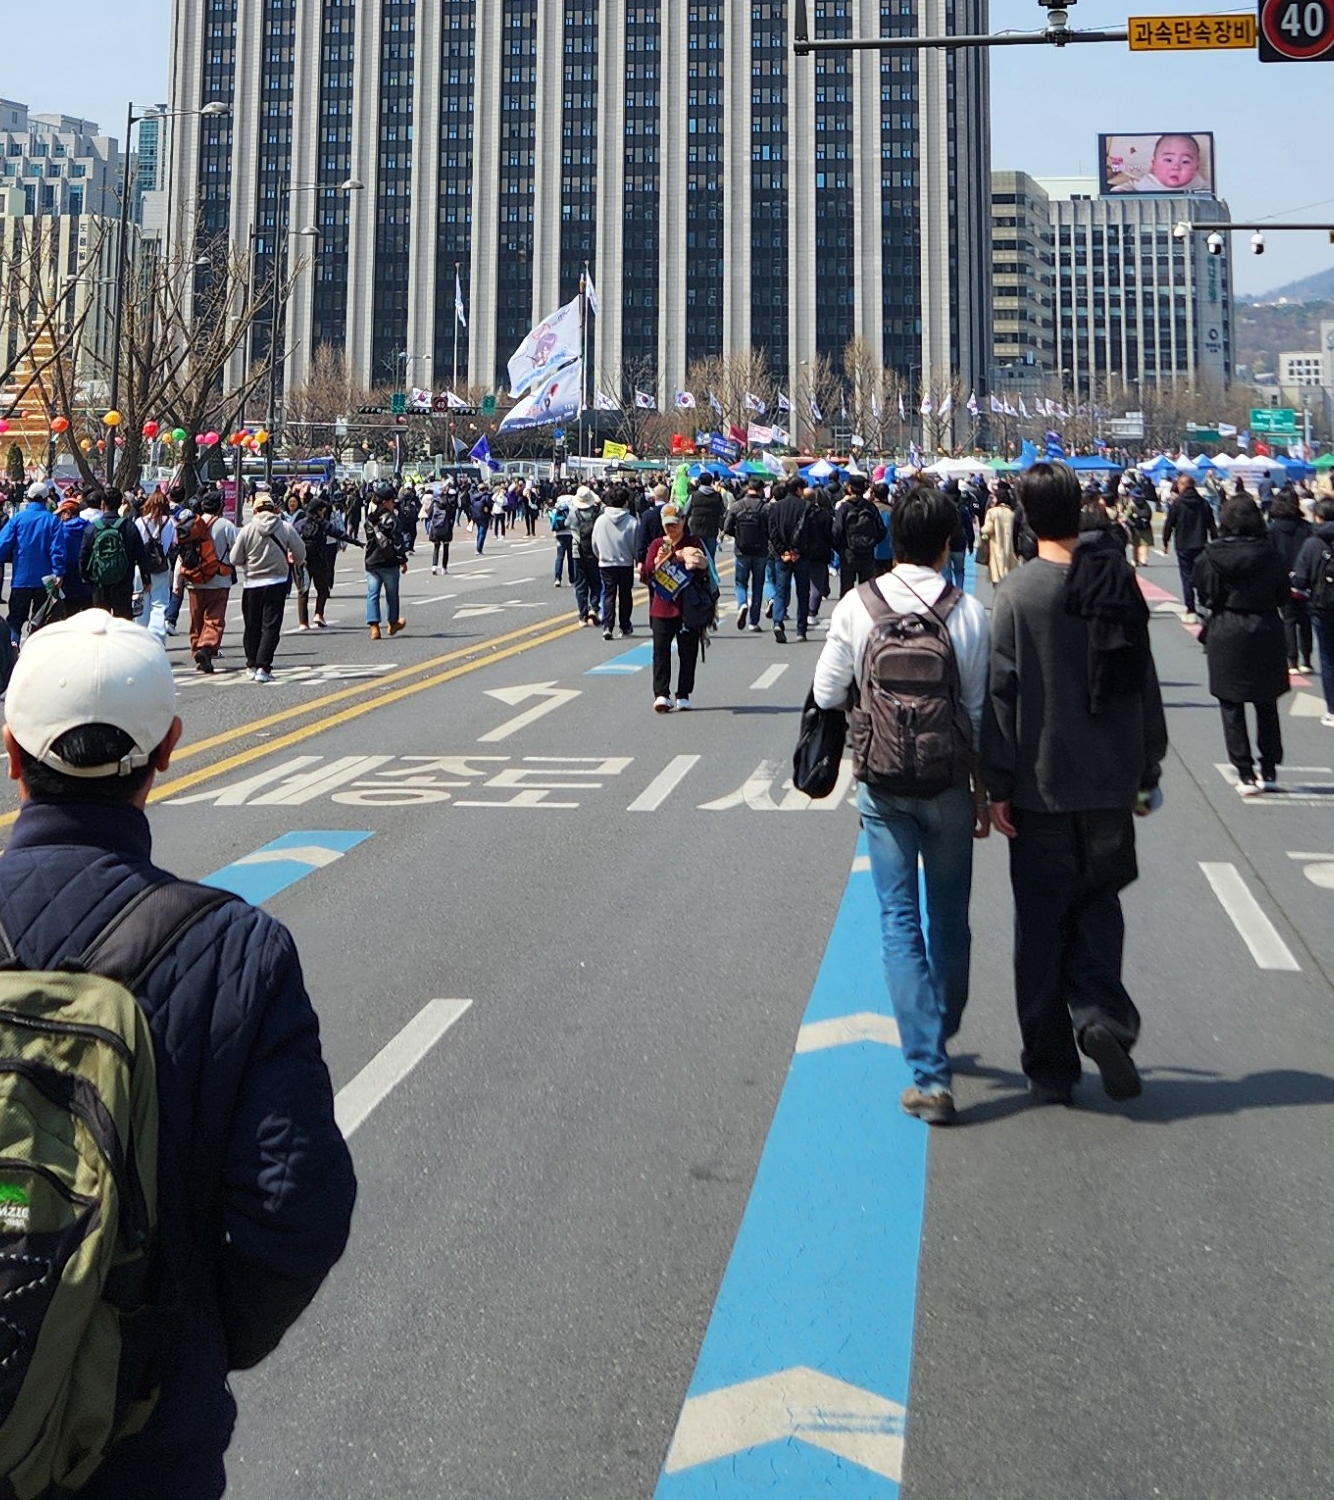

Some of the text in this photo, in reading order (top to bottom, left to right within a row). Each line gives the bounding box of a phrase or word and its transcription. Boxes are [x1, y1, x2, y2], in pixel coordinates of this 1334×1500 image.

[1135, 19, 1250, 45] 과속단속장비
[1280, 2, 1325, 37] 40
[162, 755, 635, 808] 세종로
